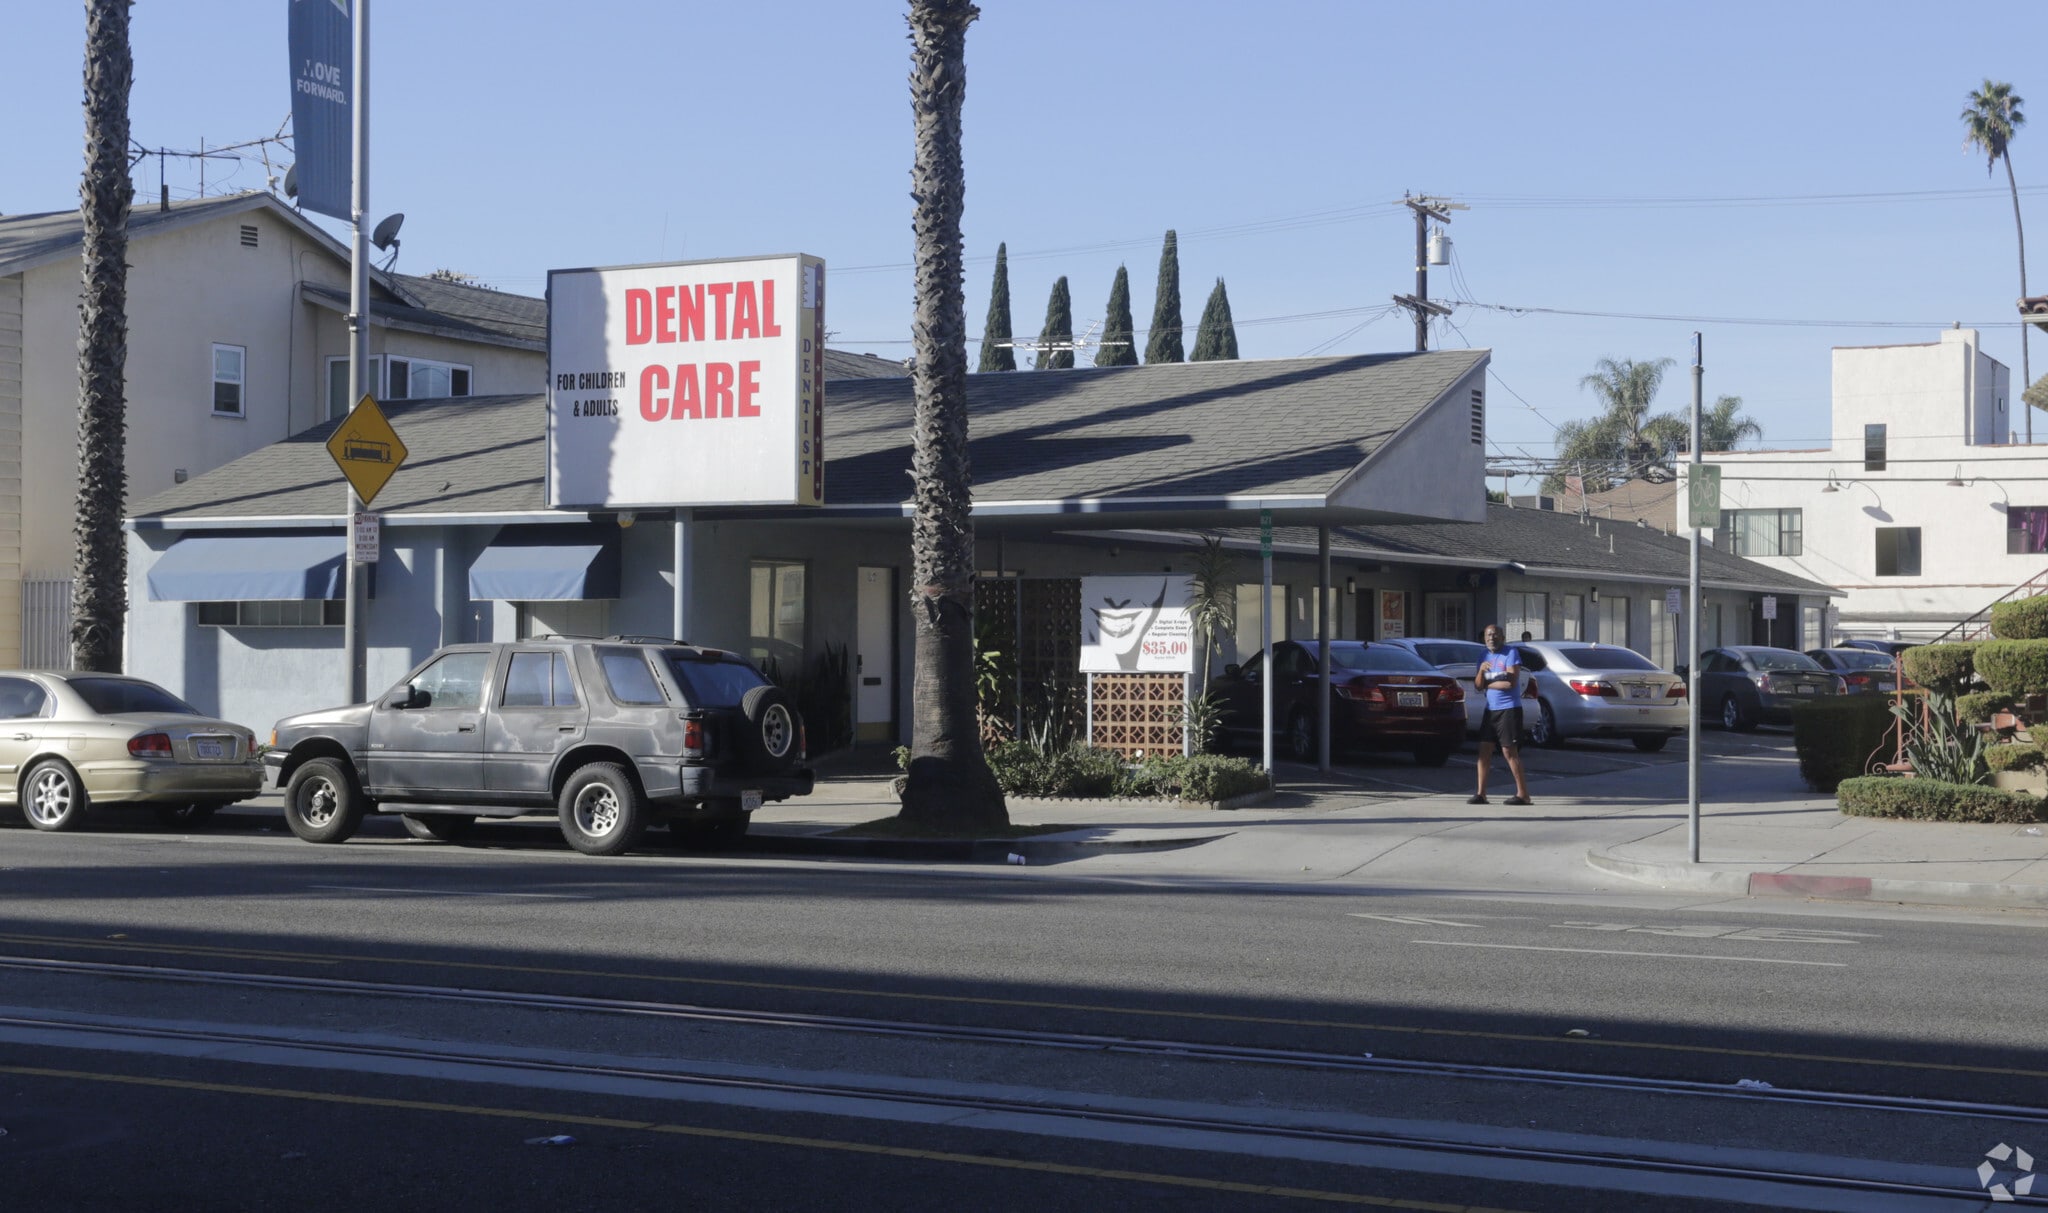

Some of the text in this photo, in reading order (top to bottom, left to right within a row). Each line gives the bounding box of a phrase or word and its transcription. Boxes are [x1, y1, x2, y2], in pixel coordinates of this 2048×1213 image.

[297, 79, 347, 104] FORWARD.
[625, 279, 781, 346] DENTAL
[557, 371, 626, 391] FOR CHILDREN
[639, 360, 761, 422] CARE
[573, 399, 619, 417] & ADULTS
[802, 338, 811, 475] DENTIST
[1142, 641, 1188, 655] $35.00
